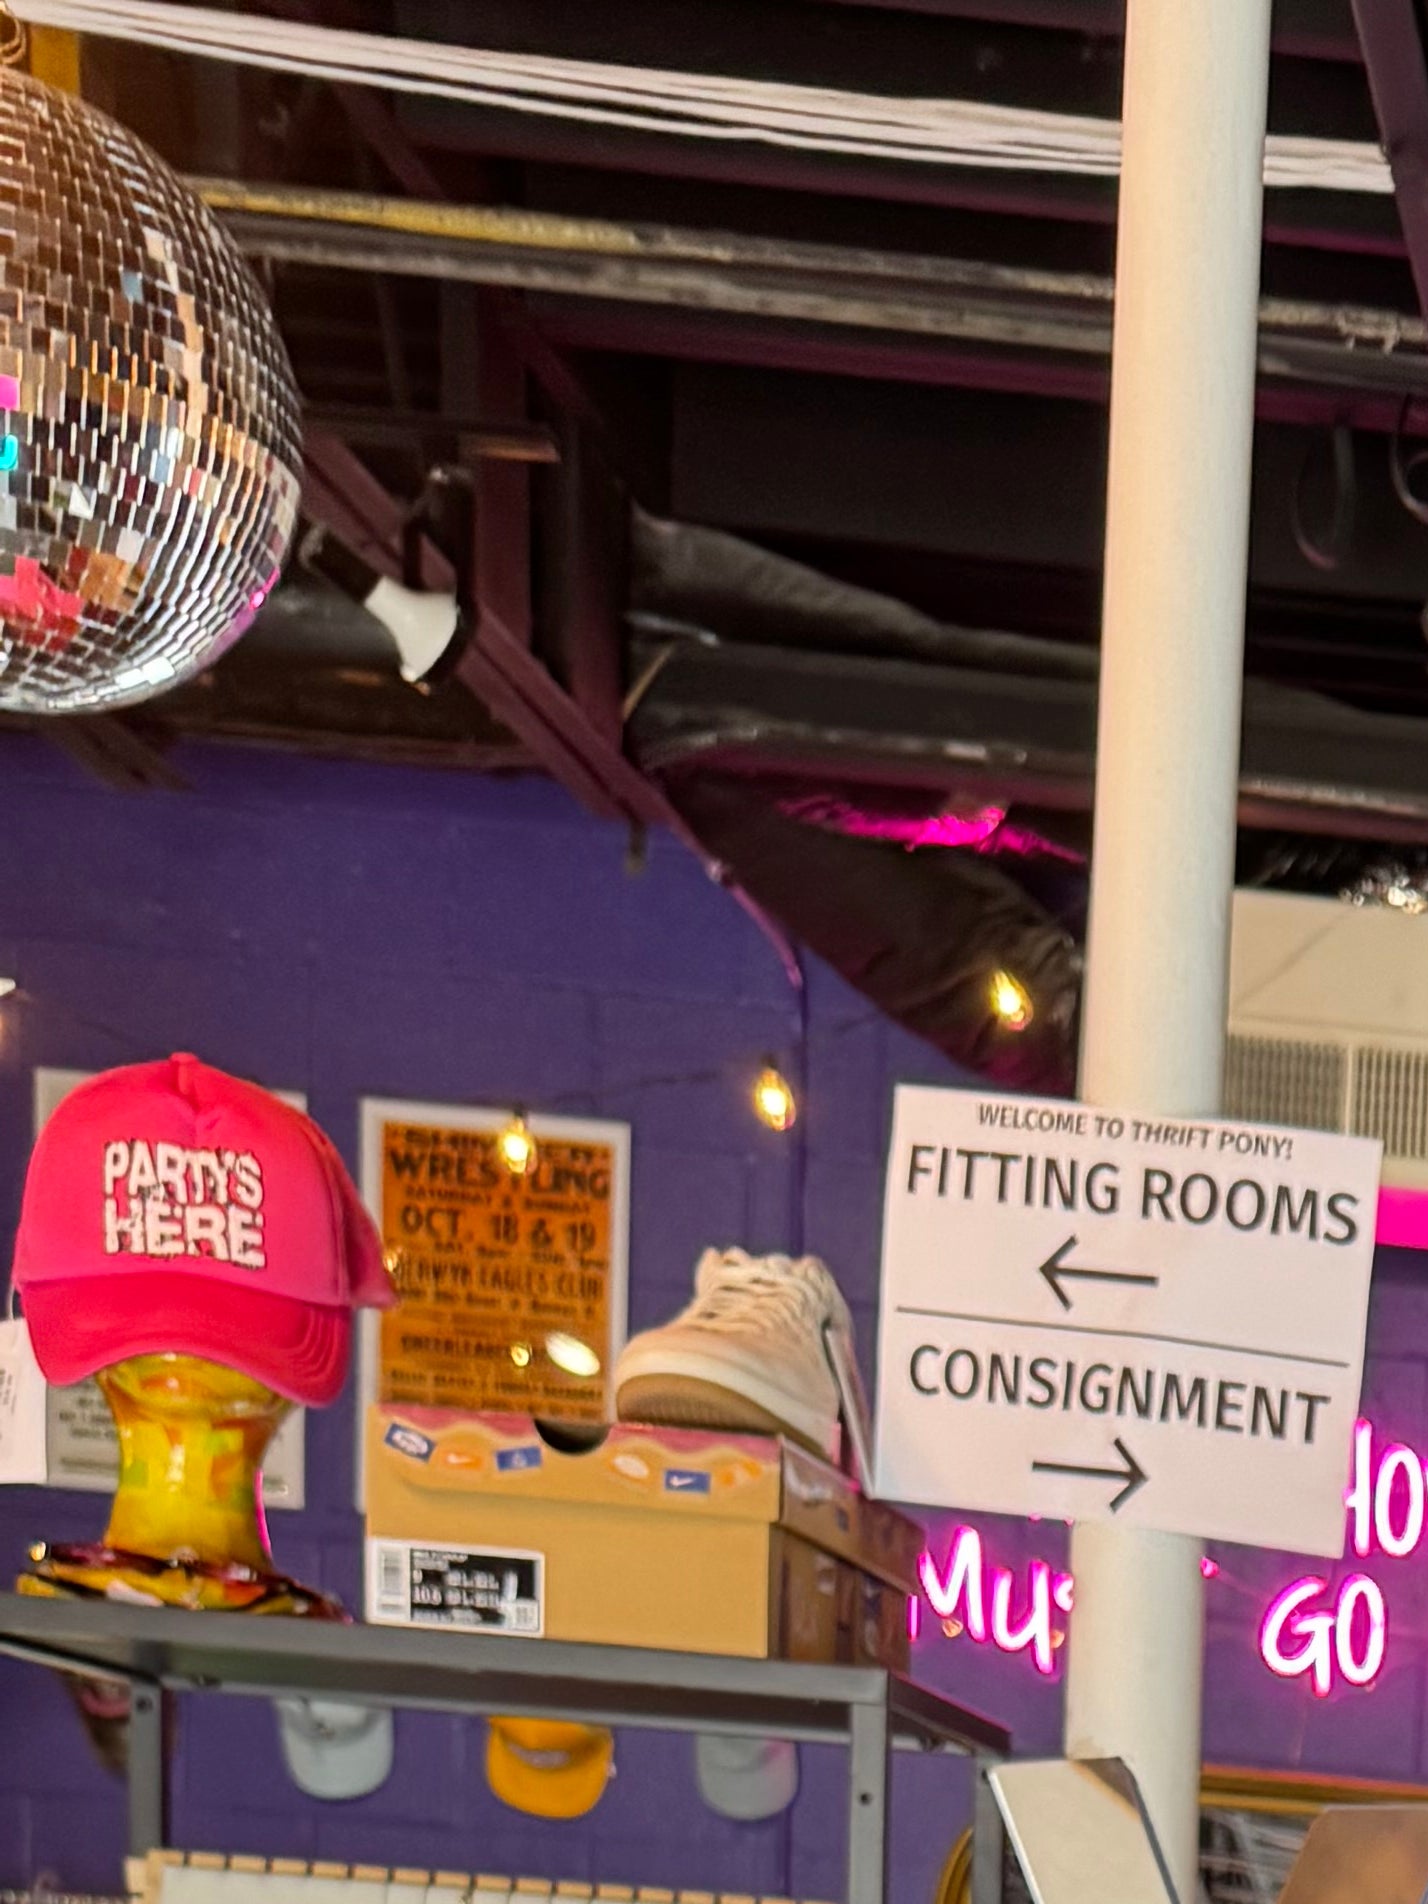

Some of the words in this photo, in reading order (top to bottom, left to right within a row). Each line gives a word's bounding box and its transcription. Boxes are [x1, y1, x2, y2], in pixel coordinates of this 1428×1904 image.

[978, 1103, 1087, 1135] WELCOME
[1095, 1116, 1125, 1140] TO
[1133, 1120, 1213, 1150] THRIFT
[1218, 1131, 1294, 1161] PONY!
[105, 1196, 266, 1270] HERE
[906, 1143, 1120, 1216] FITTING
[1141, 1167, 1361, 1246] ROOMS
[908, 1343, 1332, 1445] CONSIGNMENT
[1259, 1573, 1386, 1698] GO
